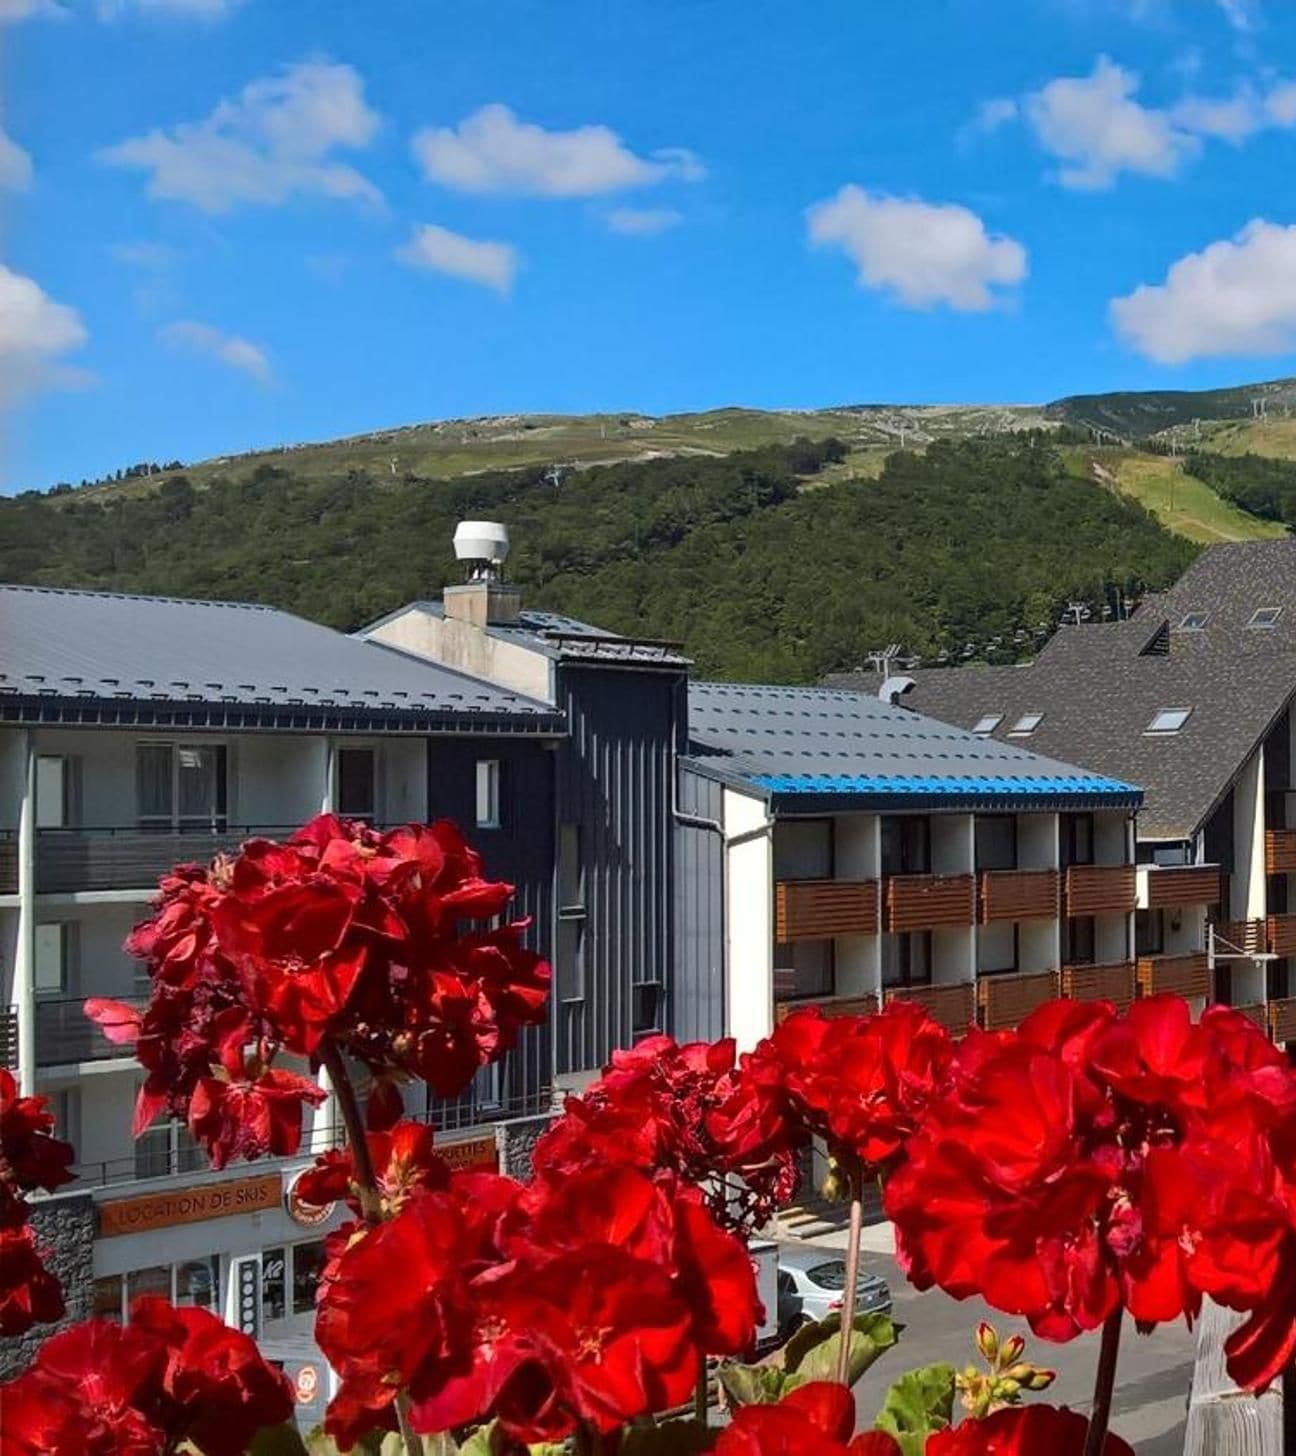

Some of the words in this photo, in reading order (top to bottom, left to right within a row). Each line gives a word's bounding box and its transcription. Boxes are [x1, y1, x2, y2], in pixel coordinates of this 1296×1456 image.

[118, 1195, 205, 1225] LOCATION
[209, 1191, 232, 1209] DE
[236, 1185, 268, 1205] SKIS
